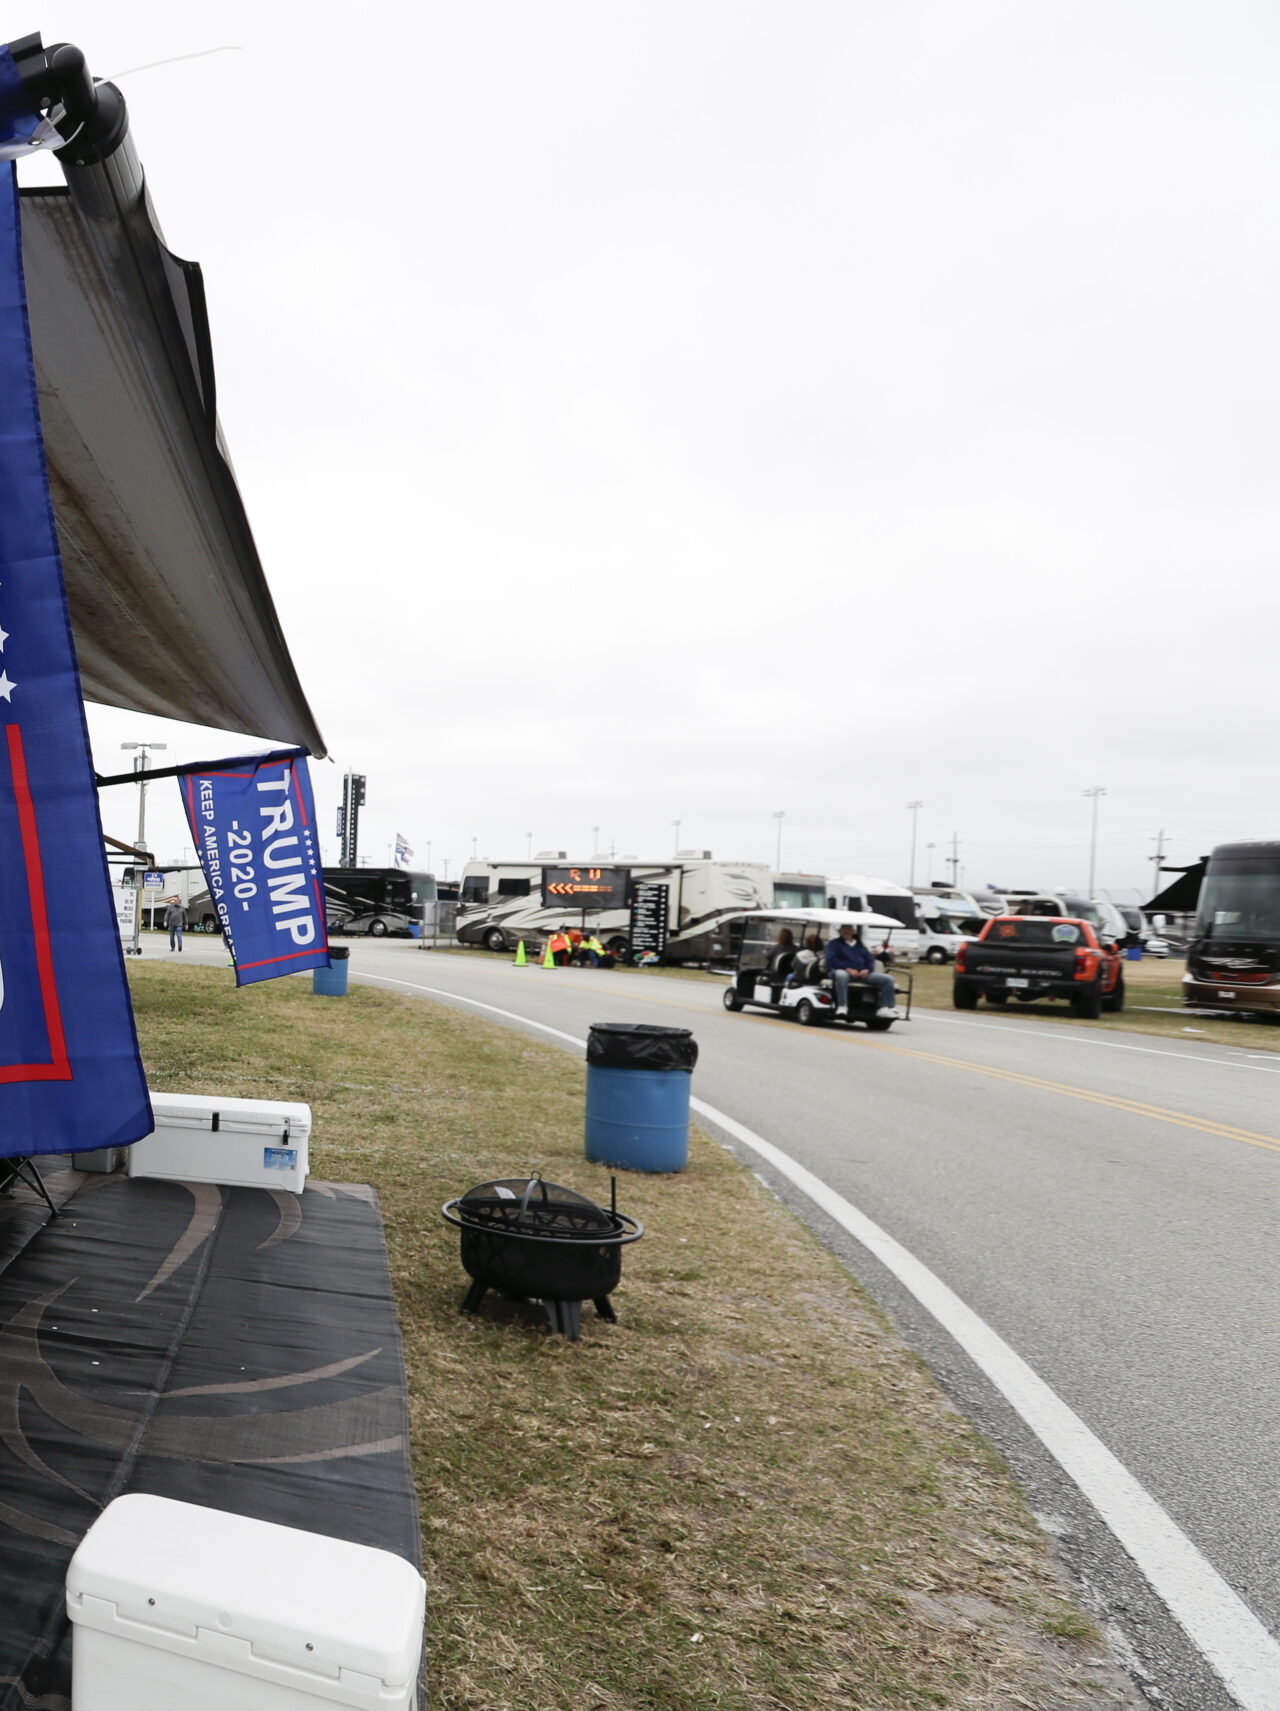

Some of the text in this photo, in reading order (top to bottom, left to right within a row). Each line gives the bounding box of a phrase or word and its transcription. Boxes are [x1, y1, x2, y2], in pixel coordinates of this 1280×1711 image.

[199, 779, 215, 821] KEEP
[203, 825, 225, 900] AMERICA
[227, 820, 258, 912] -2020-
[256, 768, 316, 946] TRUMP
